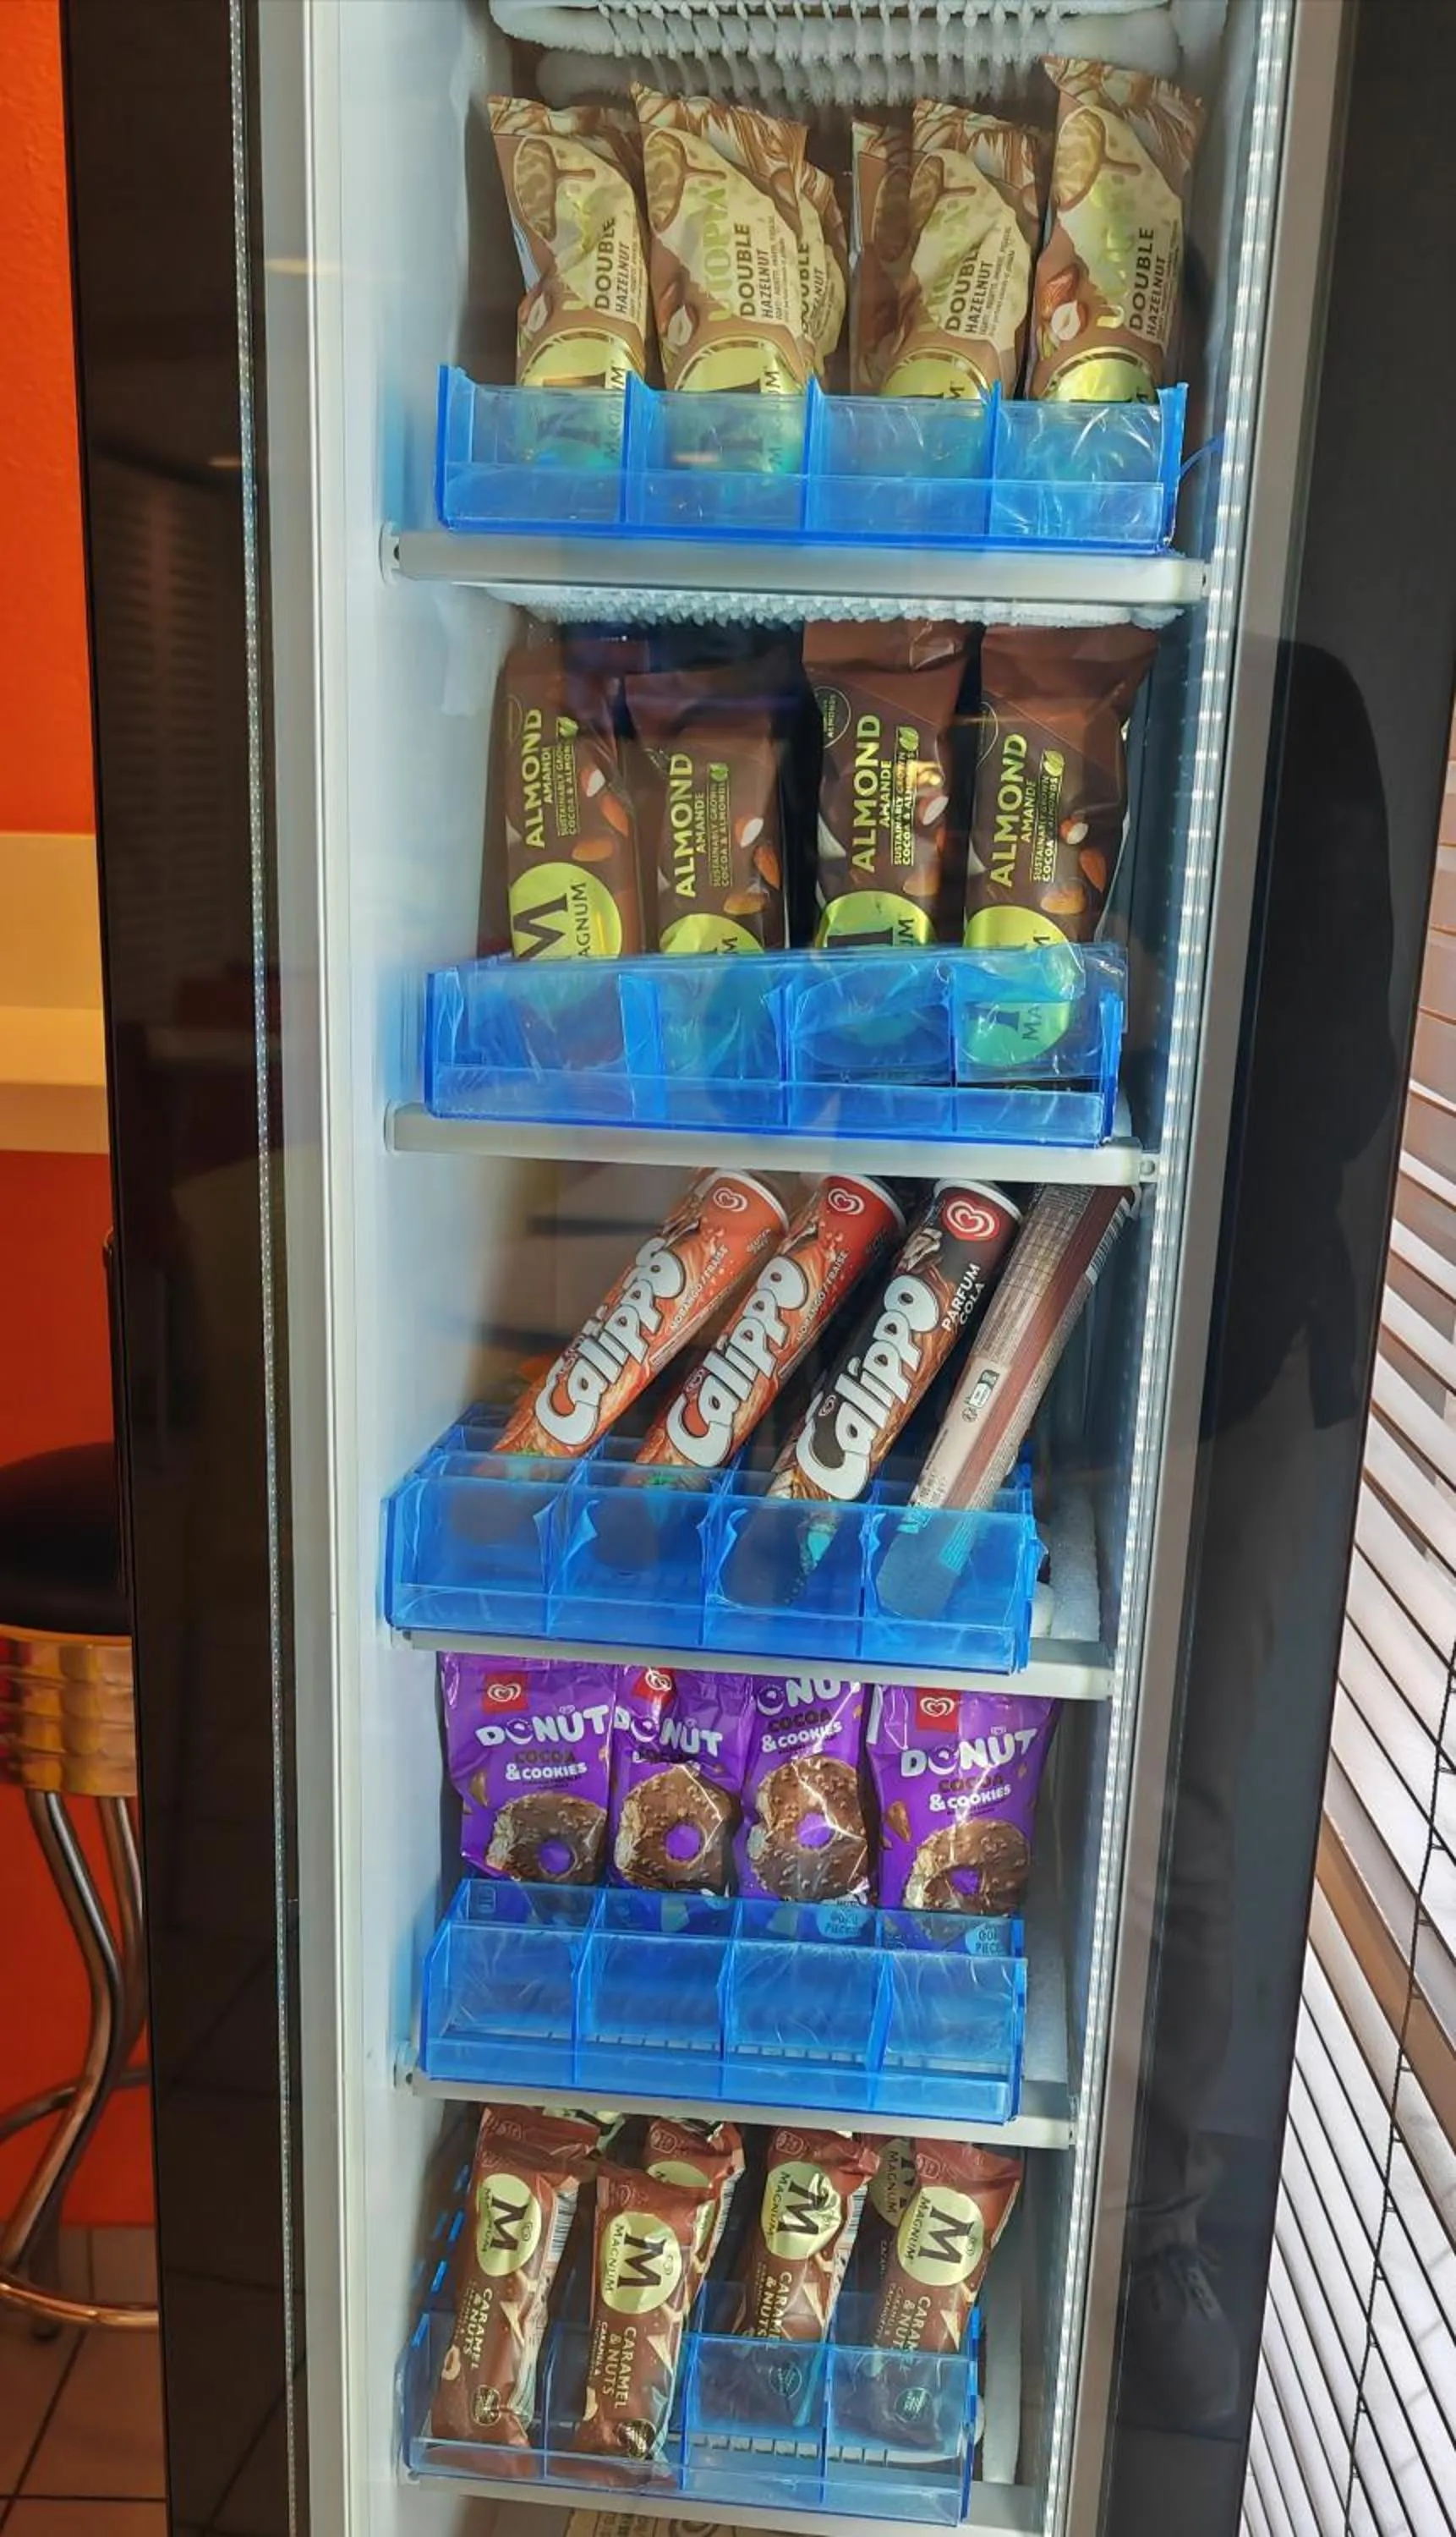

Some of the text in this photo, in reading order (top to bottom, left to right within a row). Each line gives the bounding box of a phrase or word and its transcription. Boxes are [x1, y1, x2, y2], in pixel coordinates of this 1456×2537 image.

[594, 217, 616, 310] DOUBLE
[615, 241, 631, 314] HAZELNUT
[733, 222, 756, 316] DOUBLE
[757, 249, 774, 319] HAZELNUT
[965, 260, 993, 333] HAZELNUT
[1130, 227, 1155, 330] DOUBLE
[1146, 256, 1167, 337] HAZELNUT
[522, 710, 545, 848] ALMOND
[852, 715, 880, 873] ALMOND
[879, 760, 892, 828] AMANDE
[990, 733, 1027, 887] ALMOND
[1021, 779, 1037, 843] AMANDE
[670, 753, 697, 897] ALMOND
[694, 792, 707, 853] AMANDE
[894, 795, 905, 865] SUSTAINABLY
[902, 824, 911, 865] COCOA
[1043, 840, 1054, 882] COCOA
[570, 882, 590, 958] AGNUM
[942, 1263, 981, 1331] PARFUM
[960, 1281, 985, 1326] COLA
[535, 1250, 686, 1445] Calippo
[666, 1256, 808, 1467] Calippo
[796, 1274, 939, 1500] Calippo
[474, 1704, 610, 1746] DONUT
[768, 1708, 832, 1732] COCOA
[900, 1728, 1038, 1777] DONUT
[514, 1750, 576, 1764] COCOA
[769, 2171, 791, 2235] MAGNUM
[886, 2151, 899, 2214] MAGNUM
[605, 2223, 625, 2291] MAGNUM
[906, 2196, 932, 2260] MAGNUM
[463, 2308, 480, 2355] NUTS
[471, 2288, 493, 2371] CARAMEL
[602, 2348, 620, 2396] NUTS
[614, 2326, 637, 2409] CARAMEL
